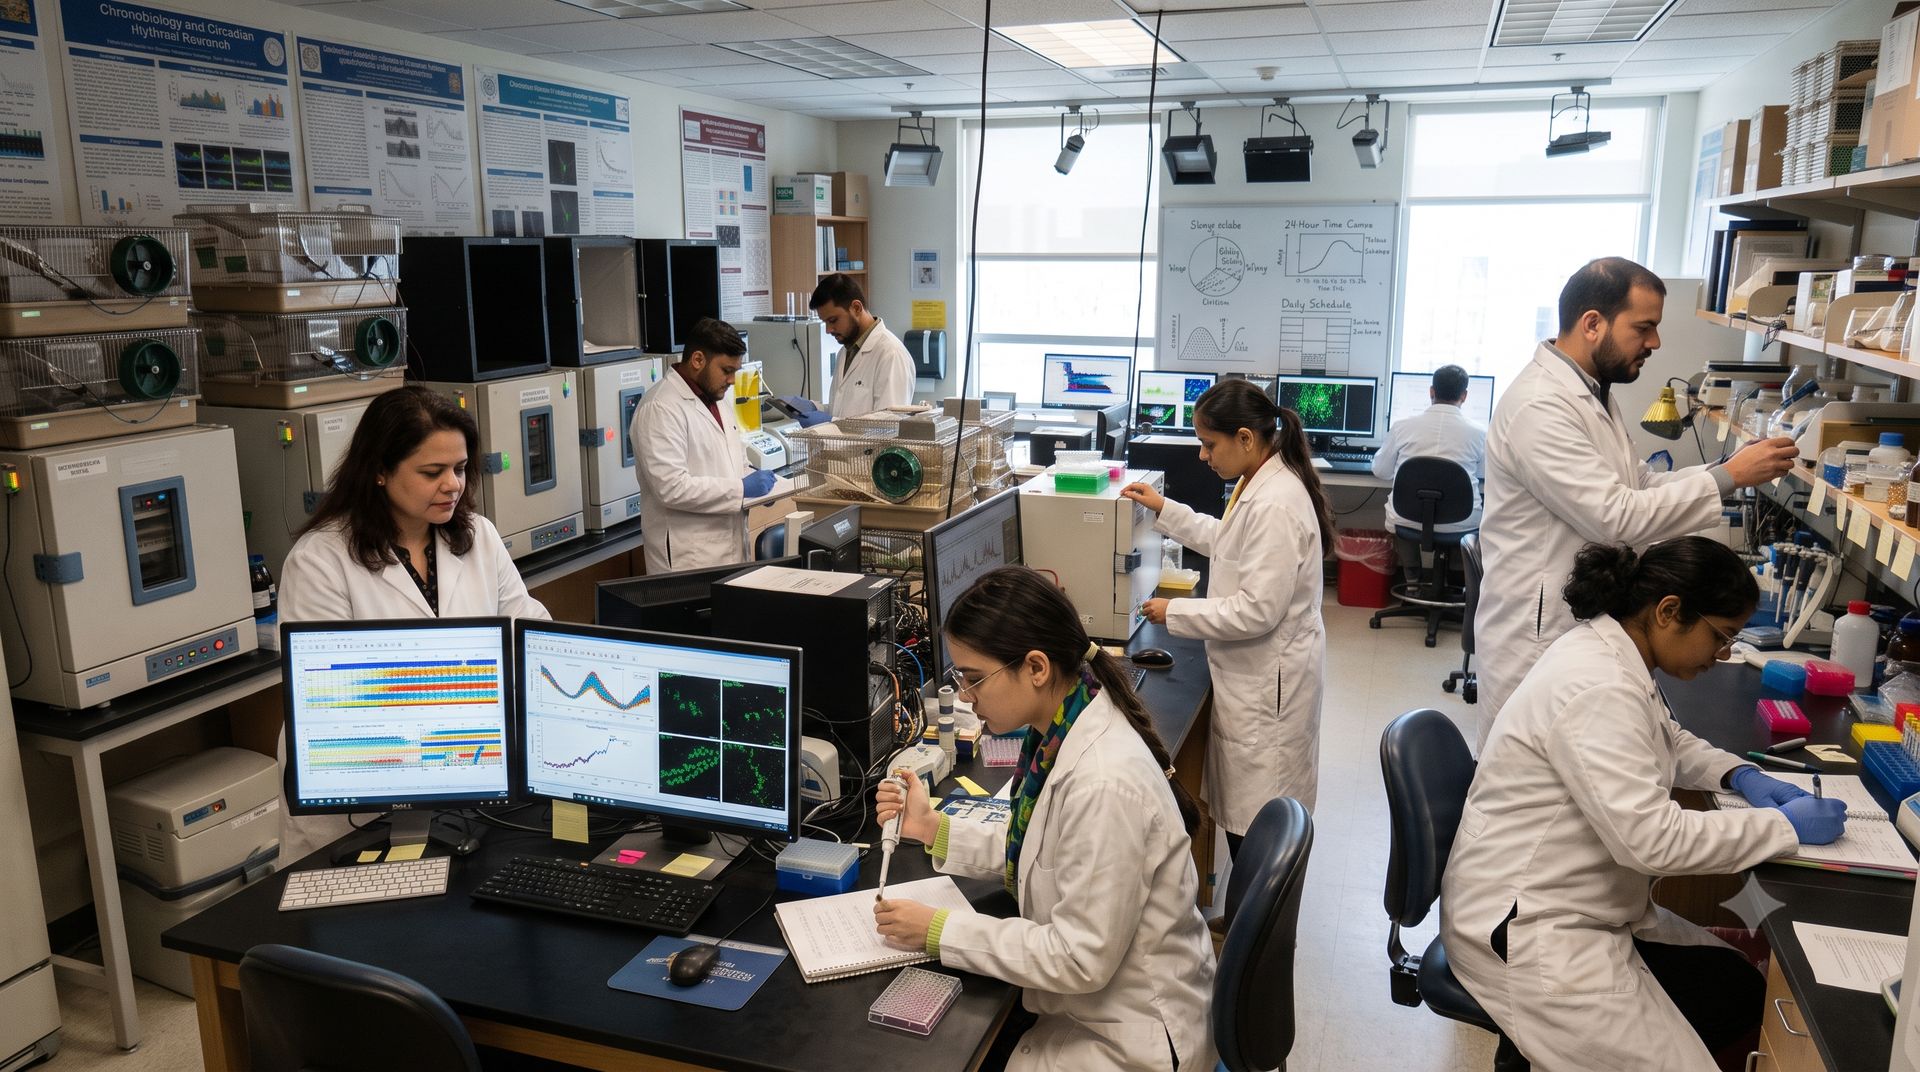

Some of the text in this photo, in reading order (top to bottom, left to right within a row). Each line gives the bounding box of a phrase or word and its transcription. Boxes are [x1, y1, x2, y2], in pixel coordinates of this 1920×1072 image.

[100, 3, 255, 41] Chronobiology and Circadian
[1322, 219, 1343, 229] Time
[1281, 298, 1352, 314] Daily Schedule
